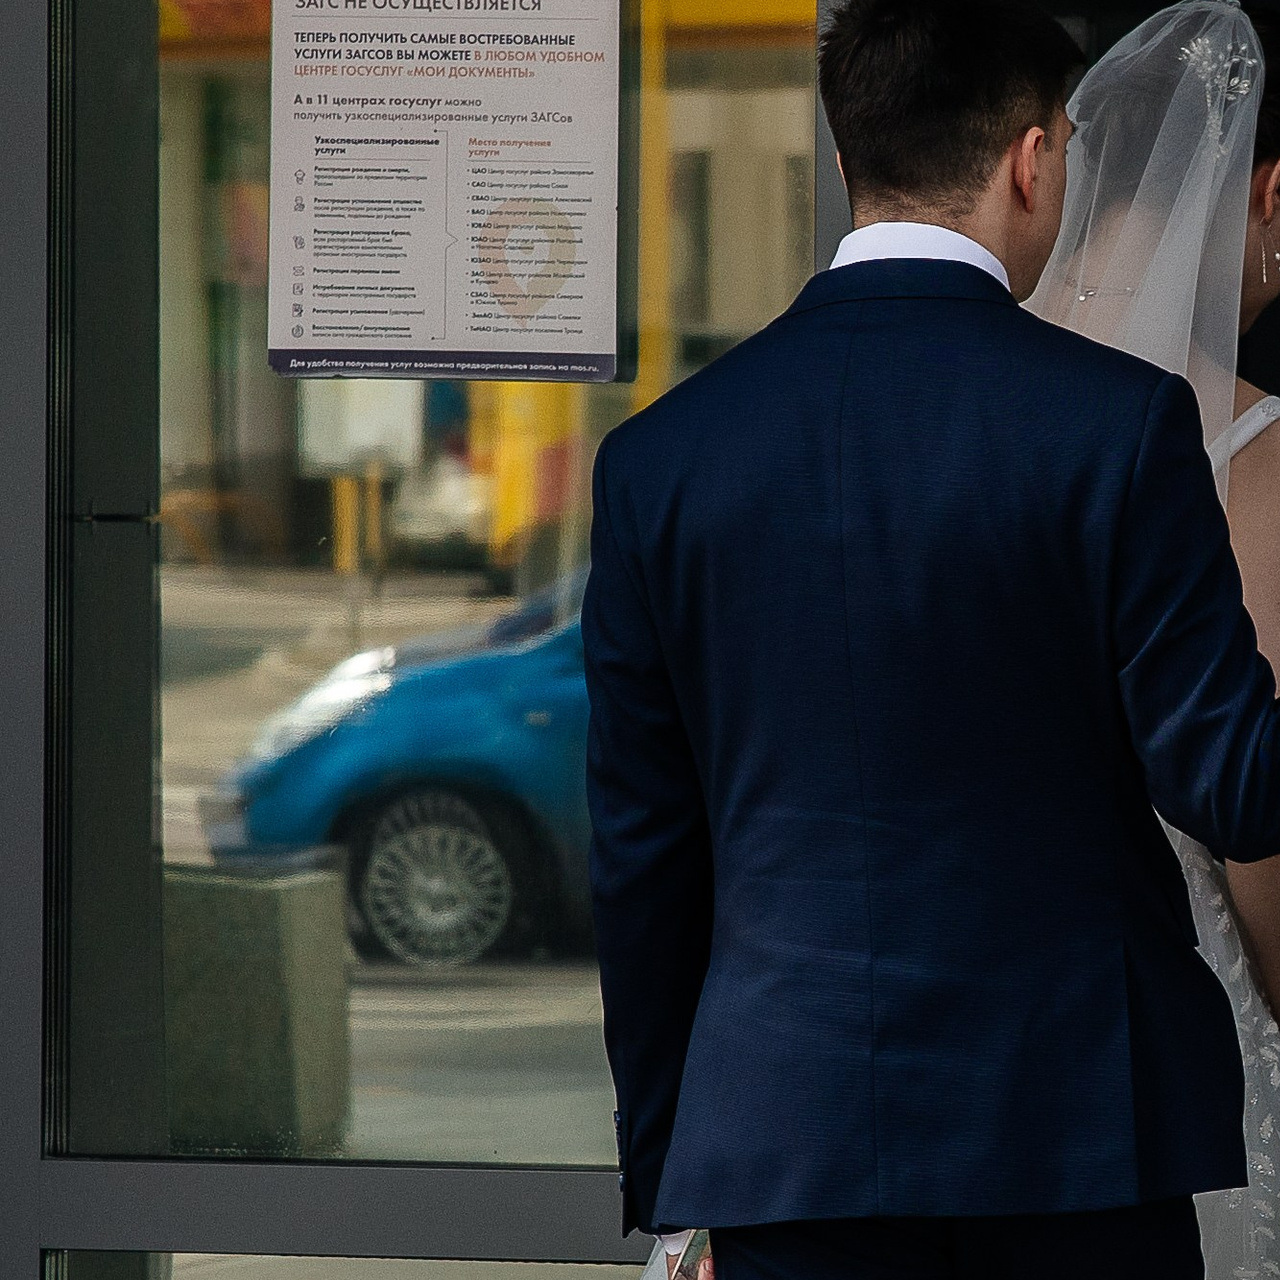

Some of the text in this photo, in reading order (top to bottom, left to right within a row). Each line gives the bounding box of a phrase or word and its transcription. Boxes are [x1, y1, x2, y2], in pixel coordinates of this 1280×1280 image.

[294, 32, 575, 46] ТЕПЕРЬ ПОЛУЧИТЬ САМЫЕ ВОСТРЕБОВАННЫЕ
[294, 49, 606, 64] УСЛУГИ ЗАГСОВ ВЫ МОЖЕТЕ В ЛЮБОМ УДОБНОМ
[294, 65, 535, 80] ЦЕНТРЕ ГОСУСЛУГ «МОИ ДОКУМЕНТЫ»
[294, 94, 482, 108] А в 11 центрах госуслуг можно
[294, 111, 573, 125] получить узкоспециализированные услуги ЗАГСов
[314, 147, 346, 156] услуги
